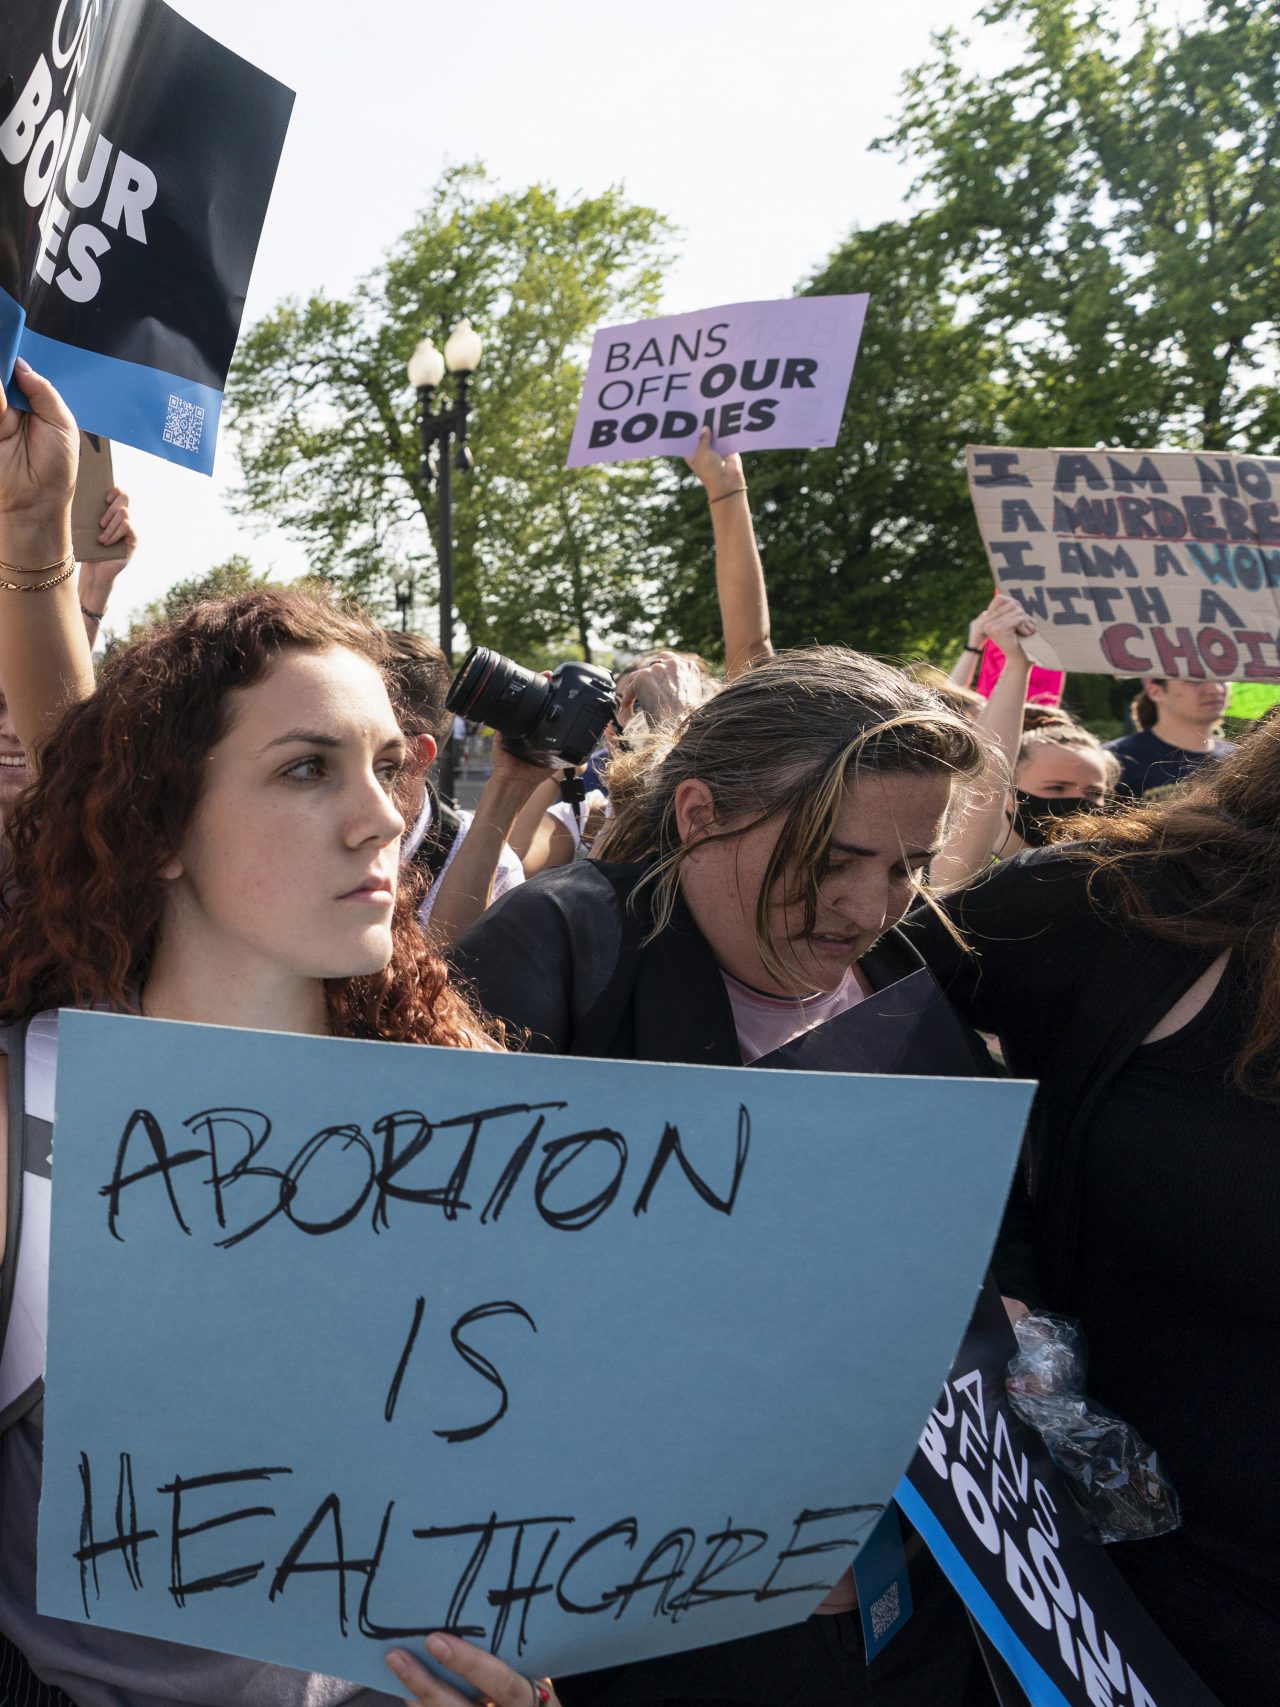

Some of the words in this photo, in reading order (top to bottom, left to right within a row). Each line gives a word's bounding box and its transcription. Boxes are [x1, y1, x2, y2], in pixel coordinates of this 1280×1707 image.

[604, 323, 730, 373] BANS
[598, 372, 692, 411] OFF
[699, 358, 818, 399] OUR
[587, 398, 779, 449] BODIES
[972, 453, 1033, 488] I
[1052, 454, 1168, 495] AM
[1001, 499, 1046, 533] A
[989, 541, 1046, 581] I
[1058, 541, 1139, 579] AM
[1153, 543, 1188, 577] A
[1008, 586, 1172, 626] WITH
[1198, 588, 1247, 628] A
[1099, 622, 1280, 679] CHOI
[98, 1100, 751, 1249] ABORTION
[384, 1296, 538, 1443] IS
[72, 1451, 885, 1656] HEALTHCARE
